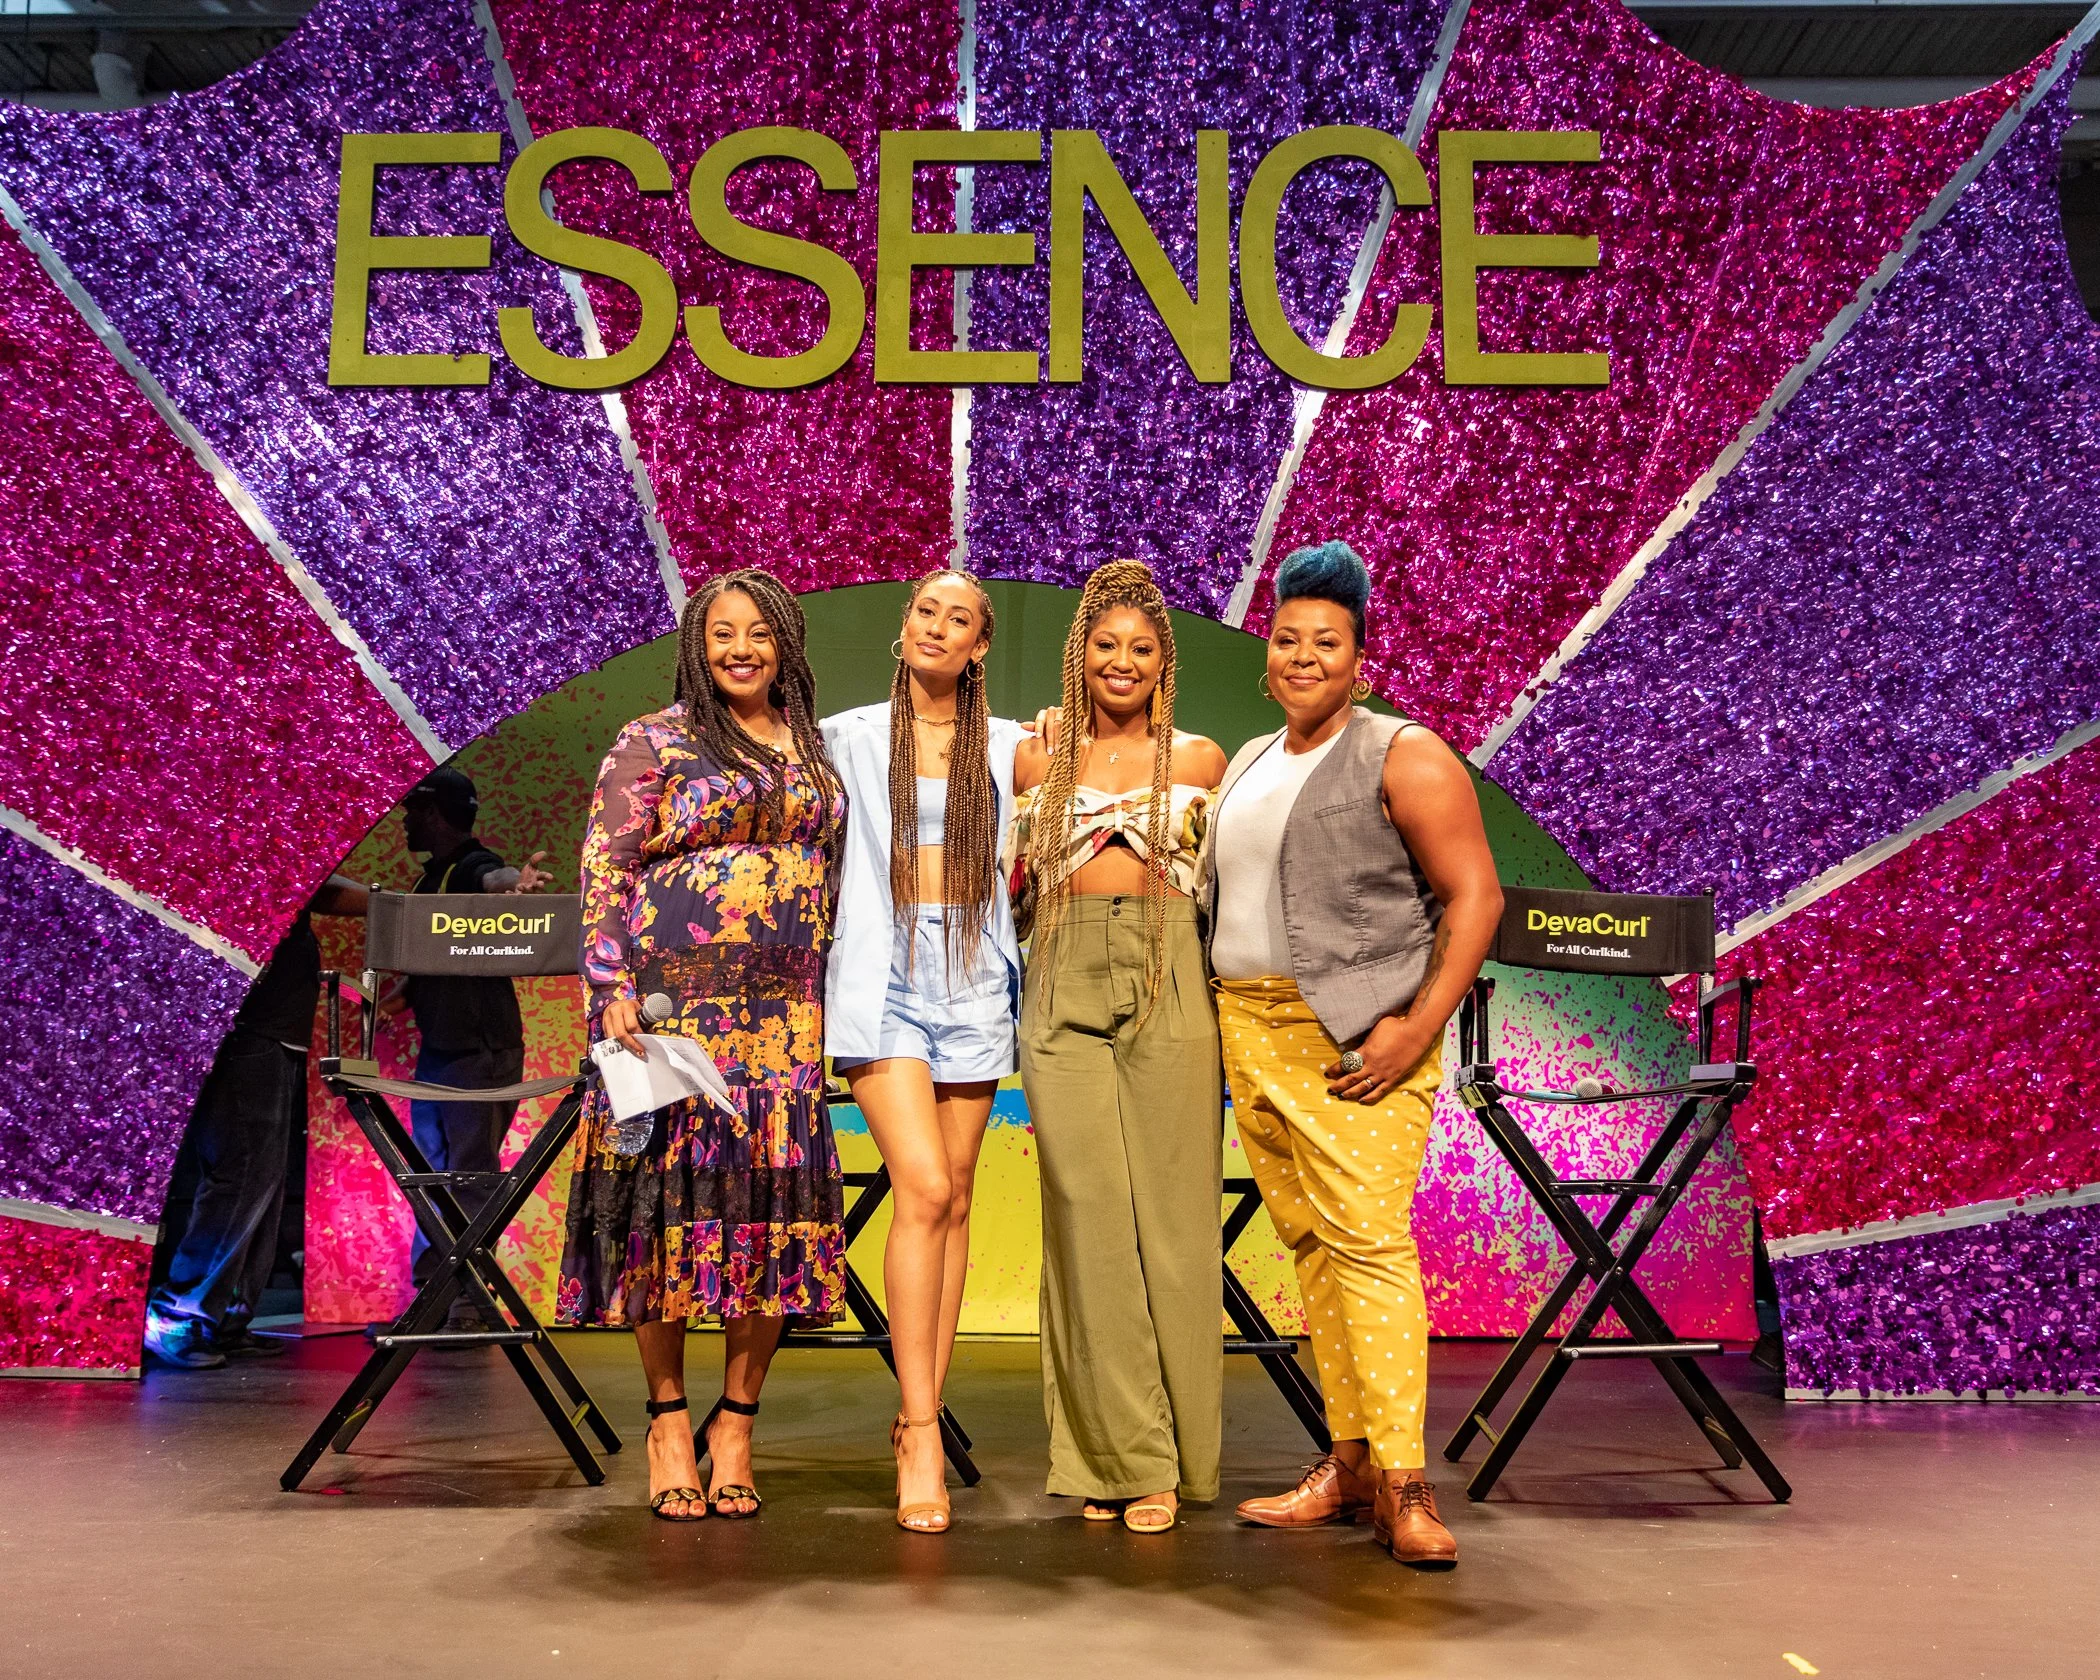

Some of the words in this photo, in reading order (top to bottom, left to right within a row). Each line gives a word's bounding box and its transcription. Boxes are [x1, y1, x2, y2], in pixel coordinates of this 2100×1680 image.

[329, 126, 1610, 389] ESSENCE
[431, 912, 551, 938] DevaCurl
[1527, 909, 1648, 938] DevaCurl
[450, 945, 468, 955] For
[469, 945, 485, 955] All
[485, 945, 534, 955] Curlkind.
[1546, 943, 1565, 953] For
[1565, 944, 1580, 954] All
[1581, 945, 1631, 958] Curlkind.
